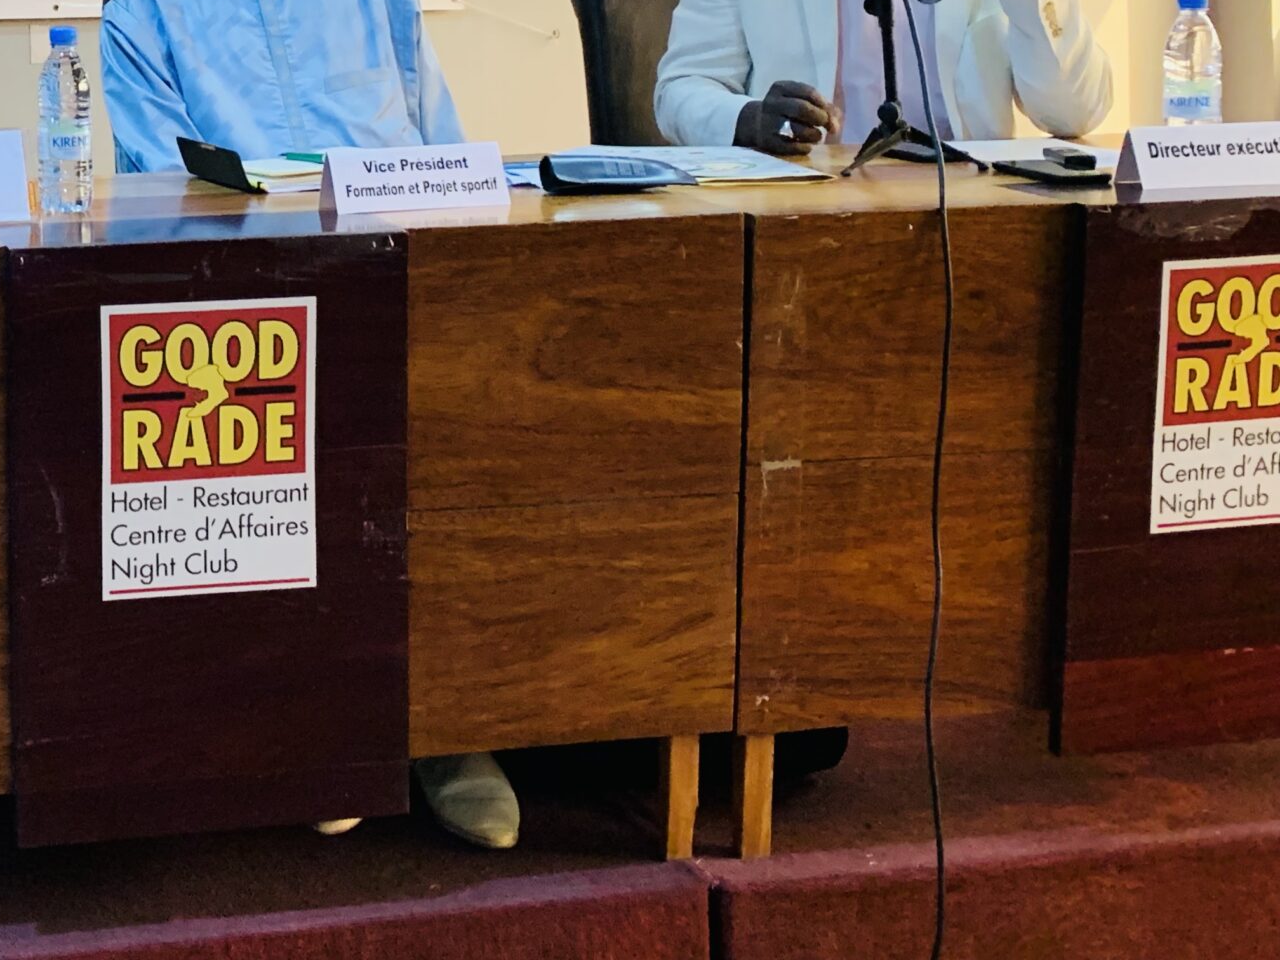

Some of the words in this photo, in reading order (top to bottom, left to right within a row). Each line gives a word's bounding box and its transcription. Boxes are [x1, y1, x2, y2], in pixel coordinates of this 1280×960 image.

[1147, 140, 1221, 159] Directeur
[1226, 137, 1280, 156] exécut
[363, 160, 396, 174] Vice
[400, 156, 469, 172] Président
[345, 182, 406, 198] Formation
[408, 184, 420, 195] et
[423, 179, 458, 196] Projet
[461, 176, 497, 195] sportif
[119, 318, 300, 387] GOOD
[122, 401, 296, 470] RADE
[1161, 427, 1211, 453] Hotel
[1160, 462, 1225, 484] Centre
[111, 485, 168, 514] Hotel
[193, 482, 309, 508] Restaurant
[1159, 490, 1216, 519] Night
[1222, 484, 1270, 510] Club
[110, 523, 187, 547] Centre
[195, 513, 309, 542] d'Affaires
[111, 552, 176, 585] Night
[184, 548, 238, 575] Club
